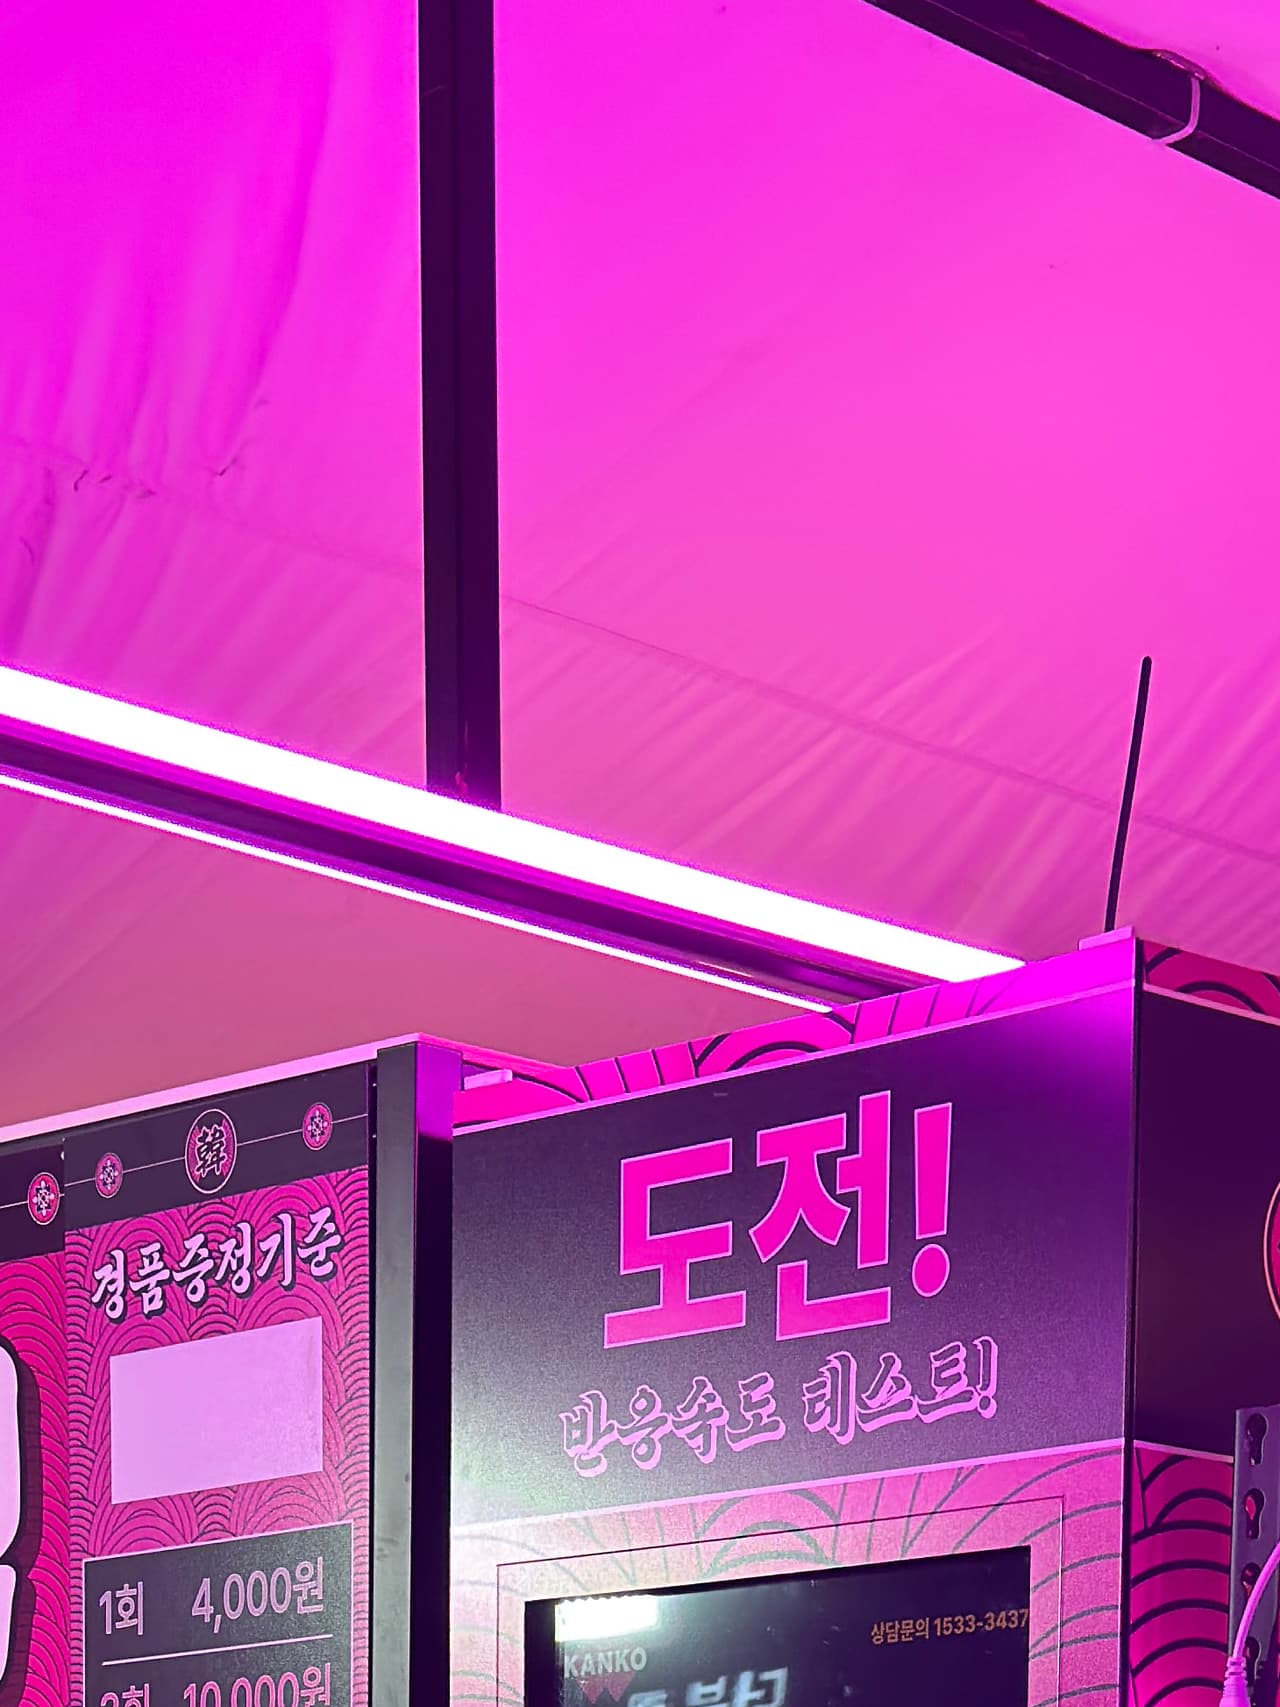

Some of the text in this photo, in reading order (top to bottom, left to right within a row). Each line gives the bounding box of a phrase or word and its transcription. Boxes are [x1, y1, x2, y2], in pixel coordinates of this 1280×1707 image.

[195, 1125, 228, 1181] 韓
[603, 1090, 953, 1349] 도전!
[91, 1208, 344, 1319] 경품증정기준
[560, 1336, 999, 1478] 반응속도 테스트!
[97, 1558, 325, 1637] 1회 4,000원
[870, 1608, 1030, 1645] 상담문의 1533-3437
[563, 1646, 648, 1679] KANKO
